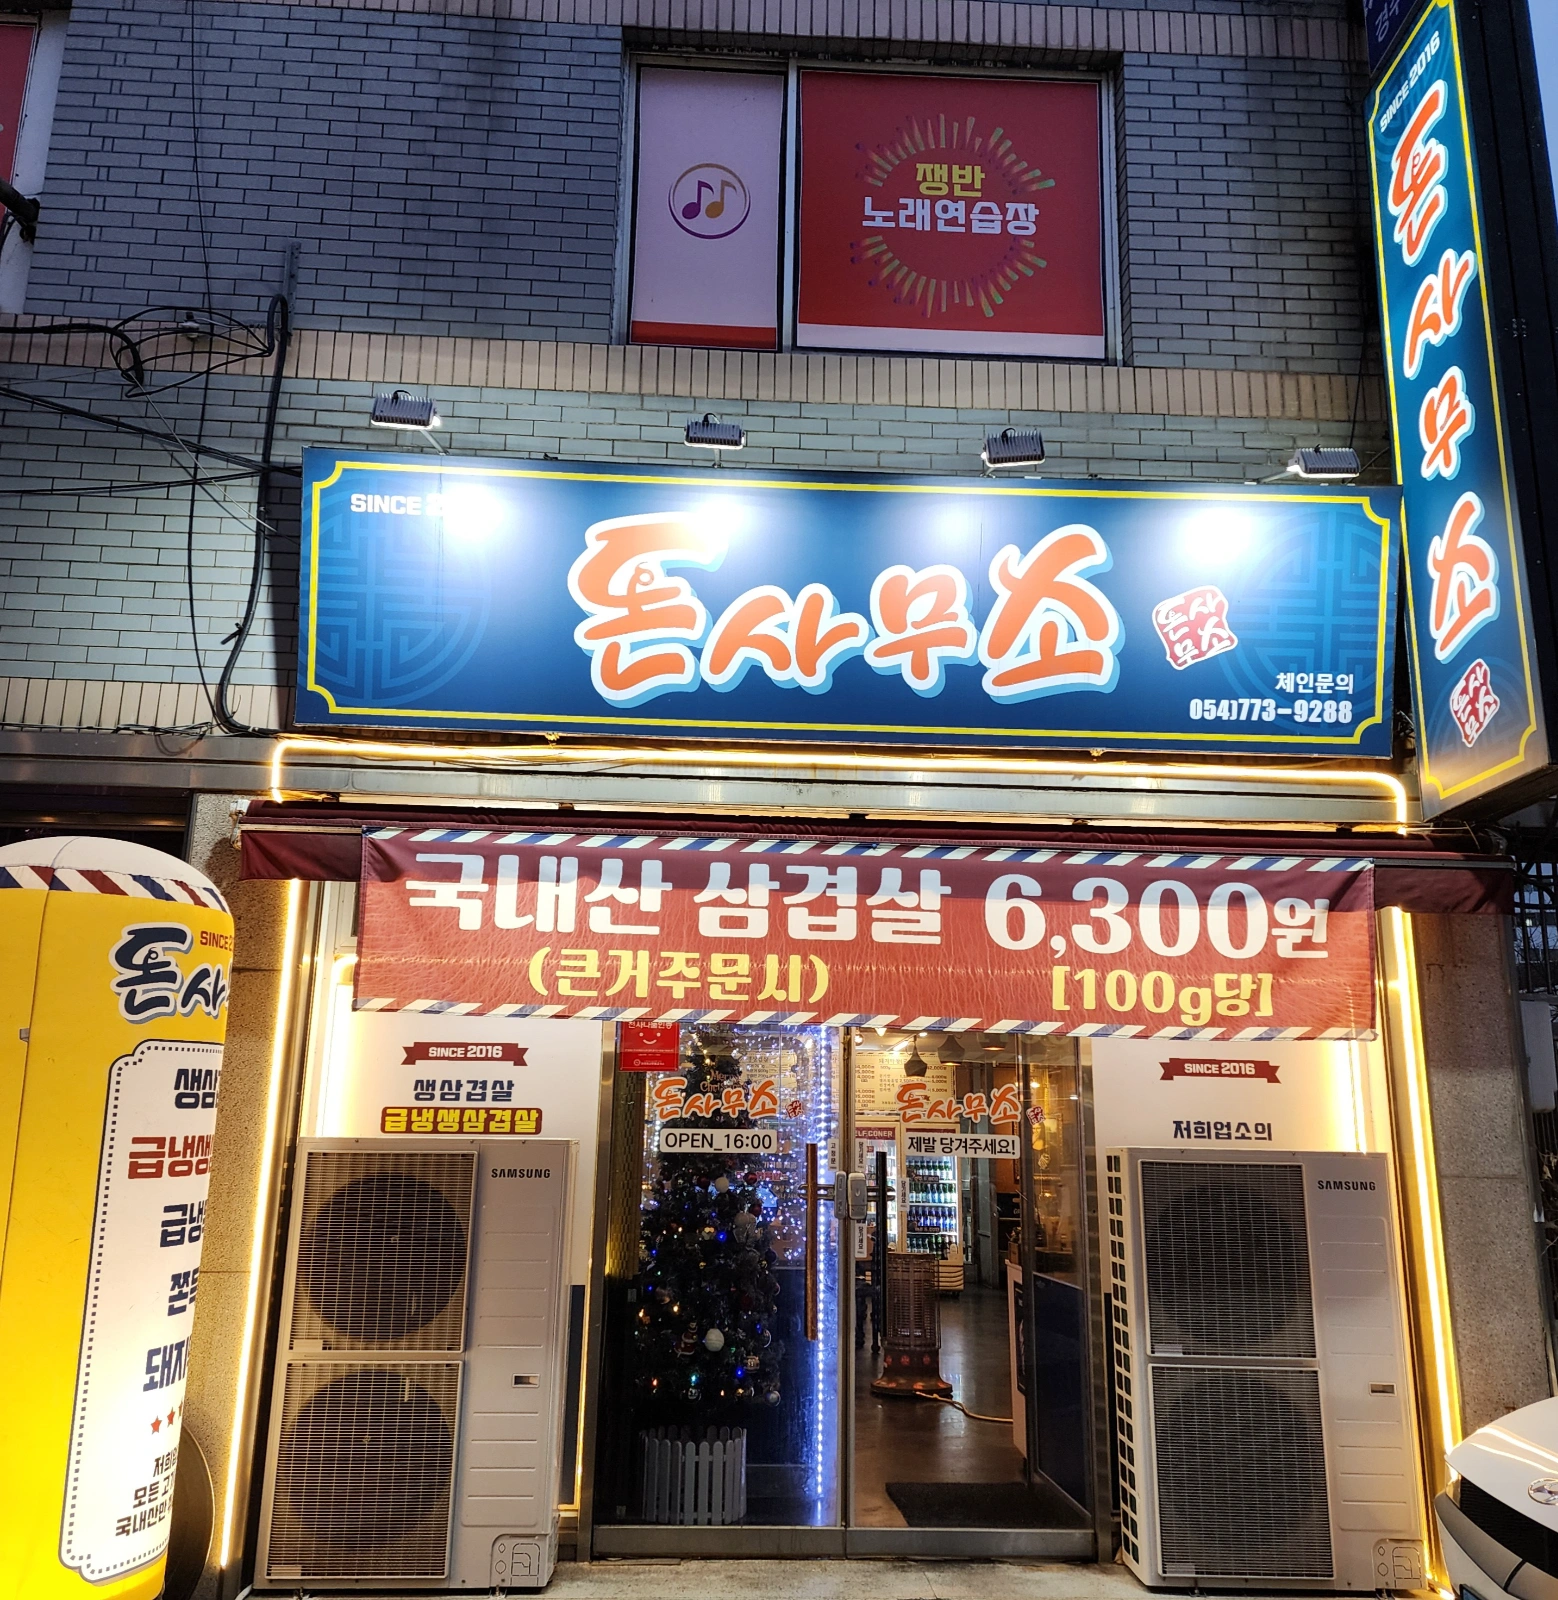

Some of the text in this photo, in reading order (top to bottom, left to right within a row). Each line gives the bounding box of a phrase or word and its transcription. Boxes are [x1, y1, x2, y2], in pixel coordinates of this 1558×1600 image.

[1380, 30, 1441, 133] SINCE 2016
[916, 163, 986, 198] 쟁반
[862, 197, 1040, 236] 노래연습장
[1387, 79, 1499, 664] 돈사무소
[350, 493, 422, 516] SINCE
[567, 511, 1124, 707] 돈사무소
[1275, 672, 1354, 694] 체인문의
[405, 853, 1330, 960] 국내산 삼겹살 6,300원
[199, 931, 228, 950] SINCE
[110, 922, 233, 1025] 돈사
[528, 946, 829, 1004] (큰거주문시)
[1051, 965, 1274, 1026] [100g당]
[428, 1045, 503, 1059] SINCE 2016
[1184, 1061, 1256, 1075] SINCE 2016
[174, 1068, 221, 1109] 생삼
[413, 1079, 515, 1102] 생삼겹살
[653, 1077, 778, 1123] 돈사무소
[896, 1082, 1022, 1125] 돈사무소
[384, 1108, 539, 1133] 급냉생삼겹살
[1173, 1120, 1273, 1141] 저희업소의
[128, 1135, 215, 1179] 급냉생
[908, 1136, 1016, 1156] 제발 당겨주세요!
[491, 1168, 551, 1179] SAMSUNG
[1317, 1179, 1377, 1192] SAMSUNG
[160, 1199, 208, 1248] 급냉
[143, 1335, 192, 1392] 돼지
[133, 1481, 159, 1509] 모든
[115, 1499, 167, 1537] 국내산만
